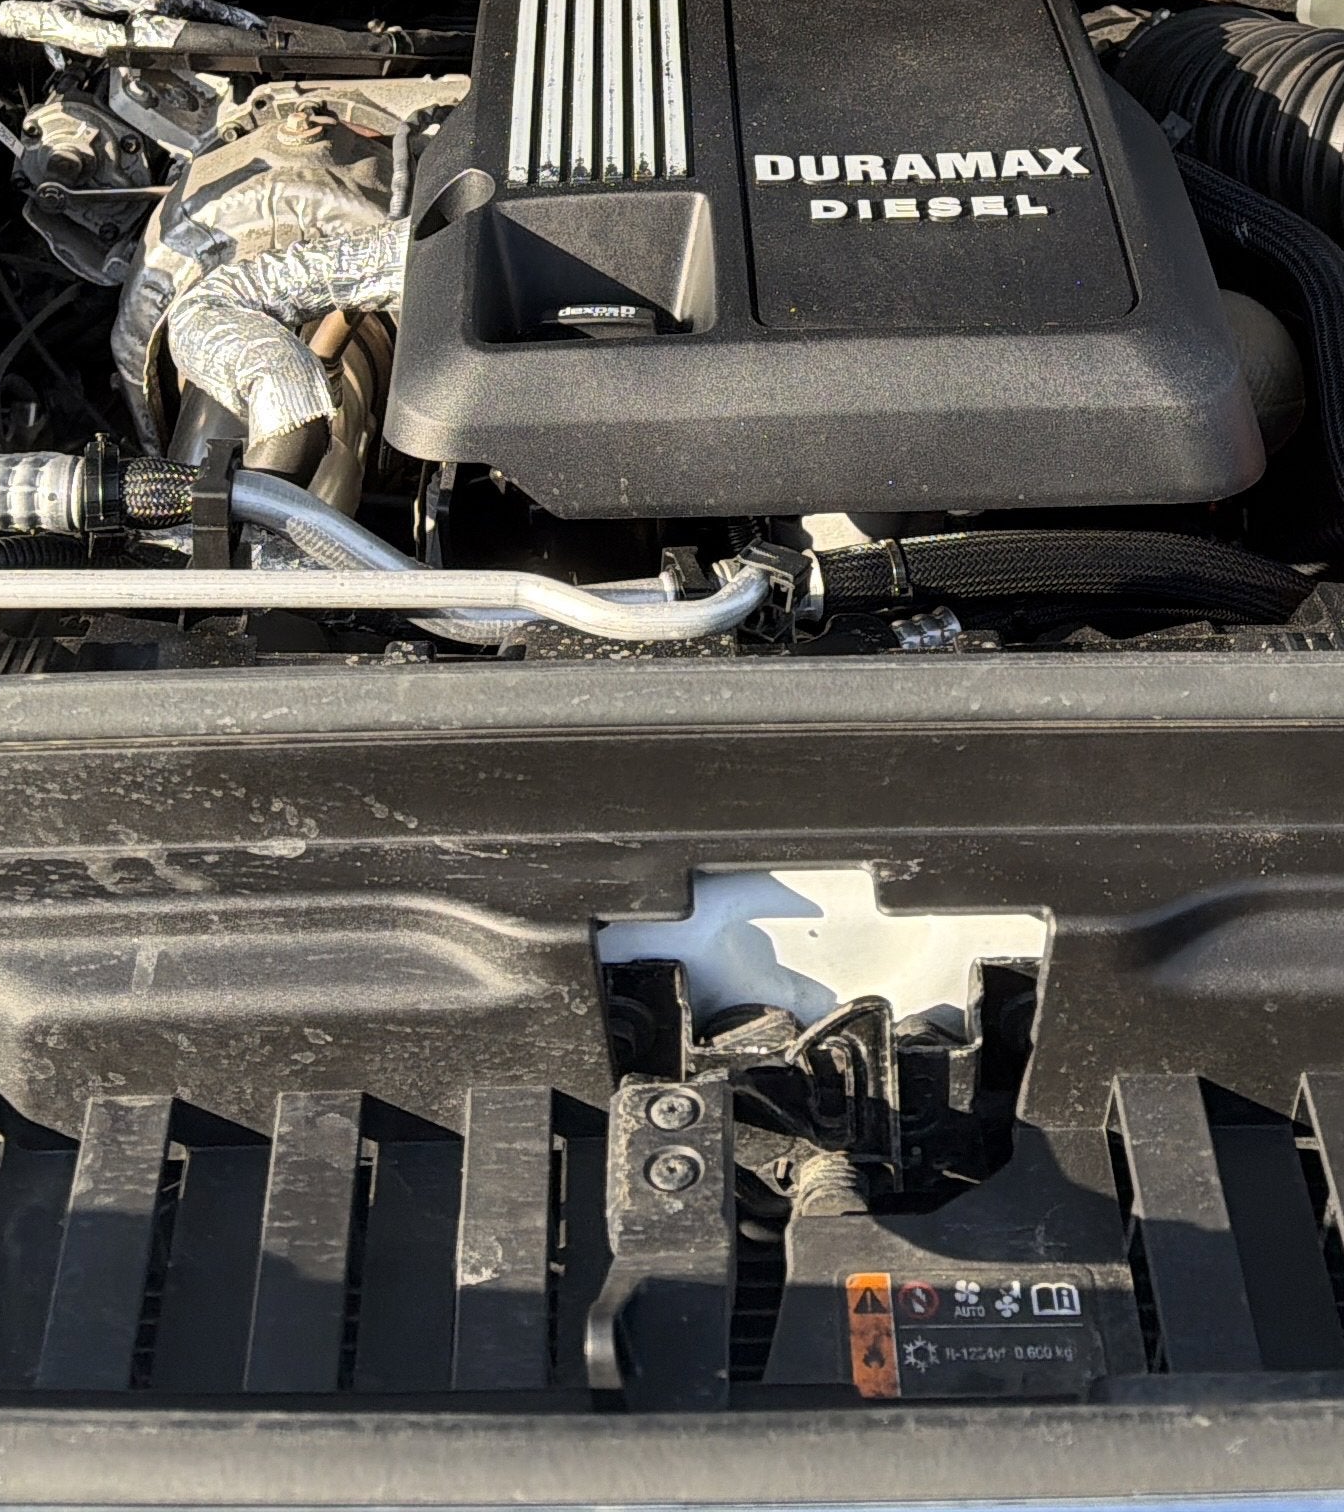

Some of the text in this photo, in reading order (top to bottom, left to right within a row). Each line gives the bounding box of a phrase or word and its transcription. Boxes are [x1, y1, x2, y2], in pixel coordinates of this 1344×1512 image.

[753, 146, 1093, 182] DURAMAX
[809, 194, 1049, 220] DIESEL
[954, 1306, 986, 1318] AUTO
